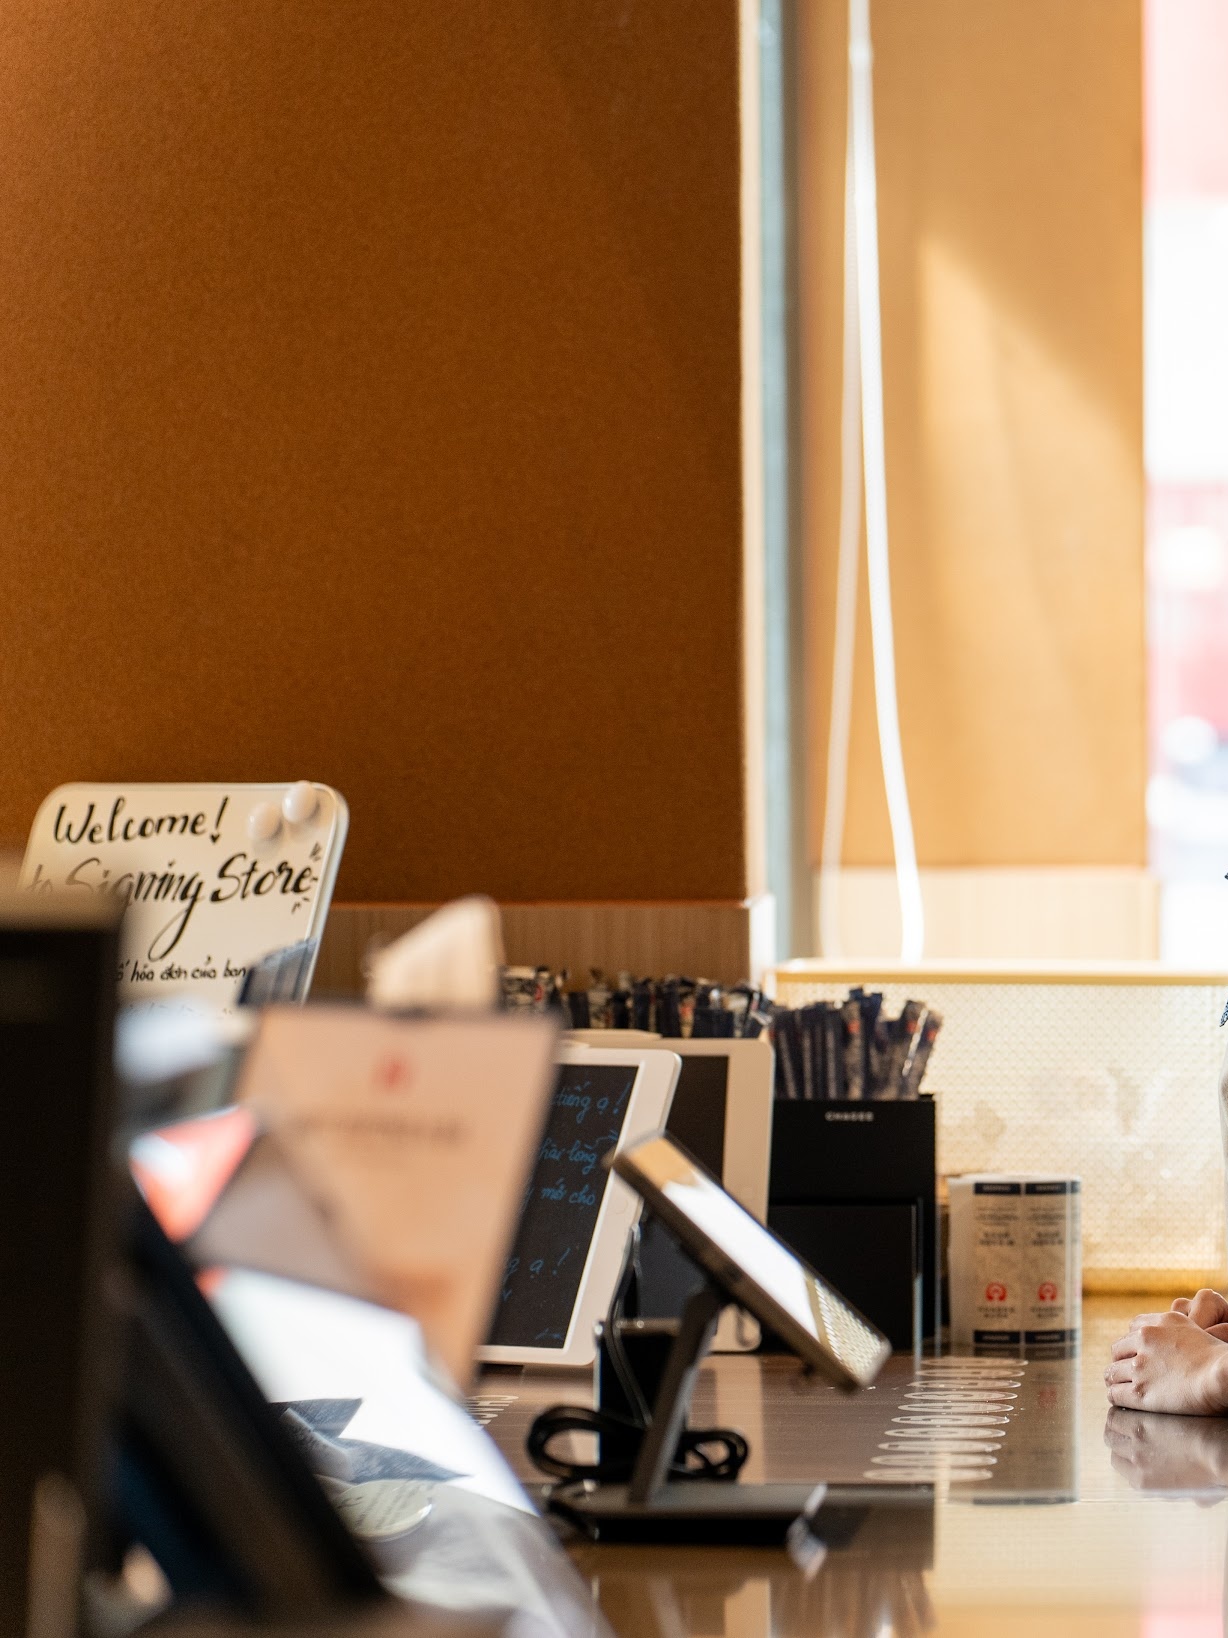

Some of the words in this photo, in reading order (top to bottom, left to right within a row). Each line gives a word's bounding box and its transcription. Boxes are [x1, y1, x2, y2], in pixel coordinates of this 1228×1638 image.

[54, 796, 229, 845] Welcome!
[65, 857, 204, 963] Signing
[210, 853, 313, 904] Store
